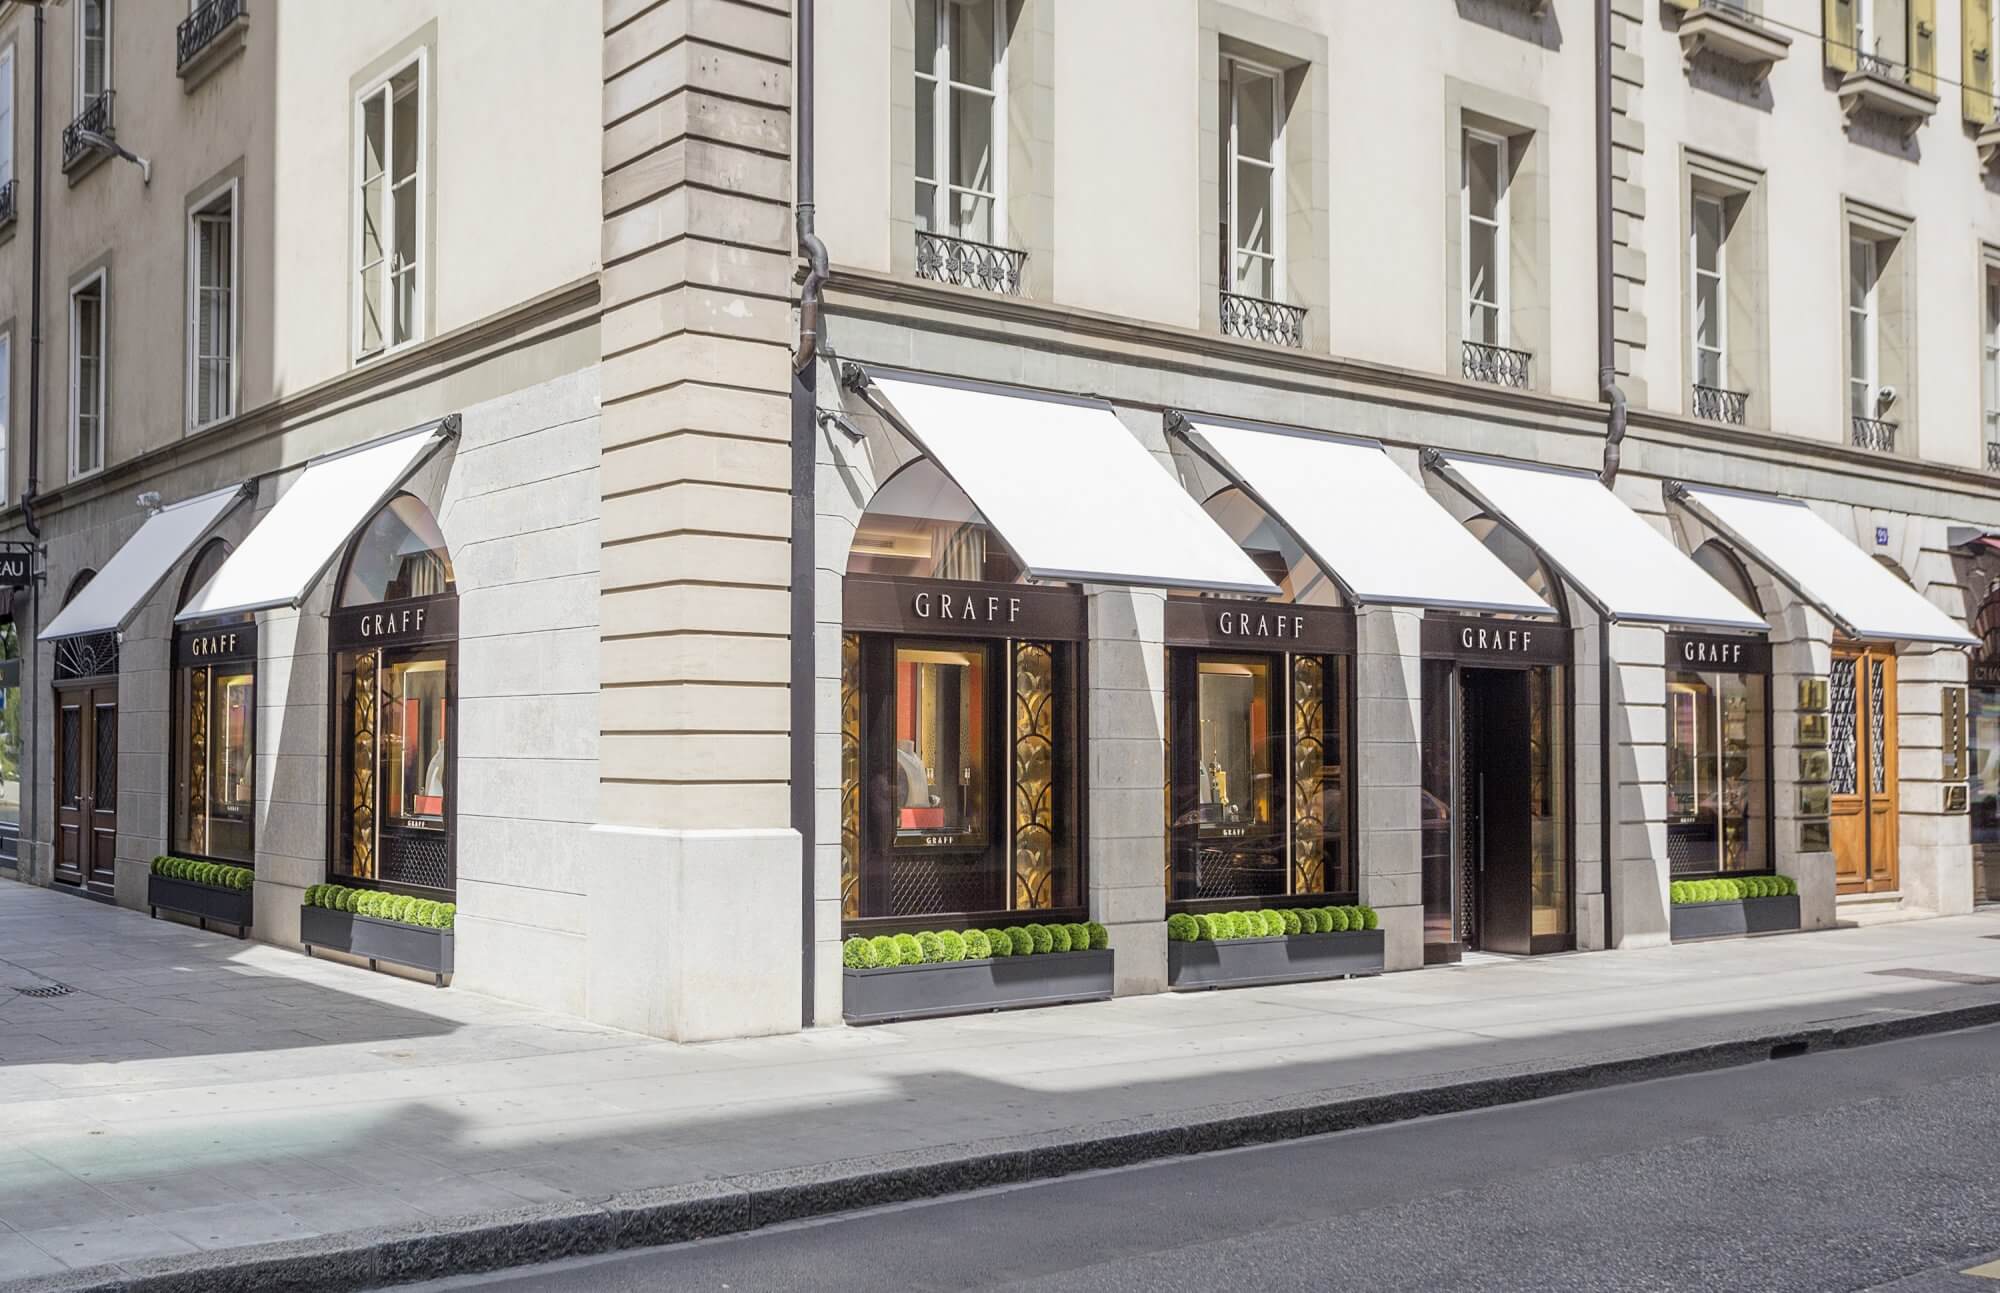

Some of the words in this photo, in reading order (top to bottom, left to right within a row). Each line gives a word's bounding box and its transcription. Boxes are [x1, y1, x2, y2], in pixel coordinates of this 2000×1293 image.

[915, 592, 1020, 622] GRAFF
[361, 608, 424, 637] GRAFF
[1220, 611, 1304, 638] GRAFF
[192, 634, 236, 656] GRAFF
[1462, 627, 1532, 652] GRAFF
[1684, 641, 1741, 663] GRAFF
